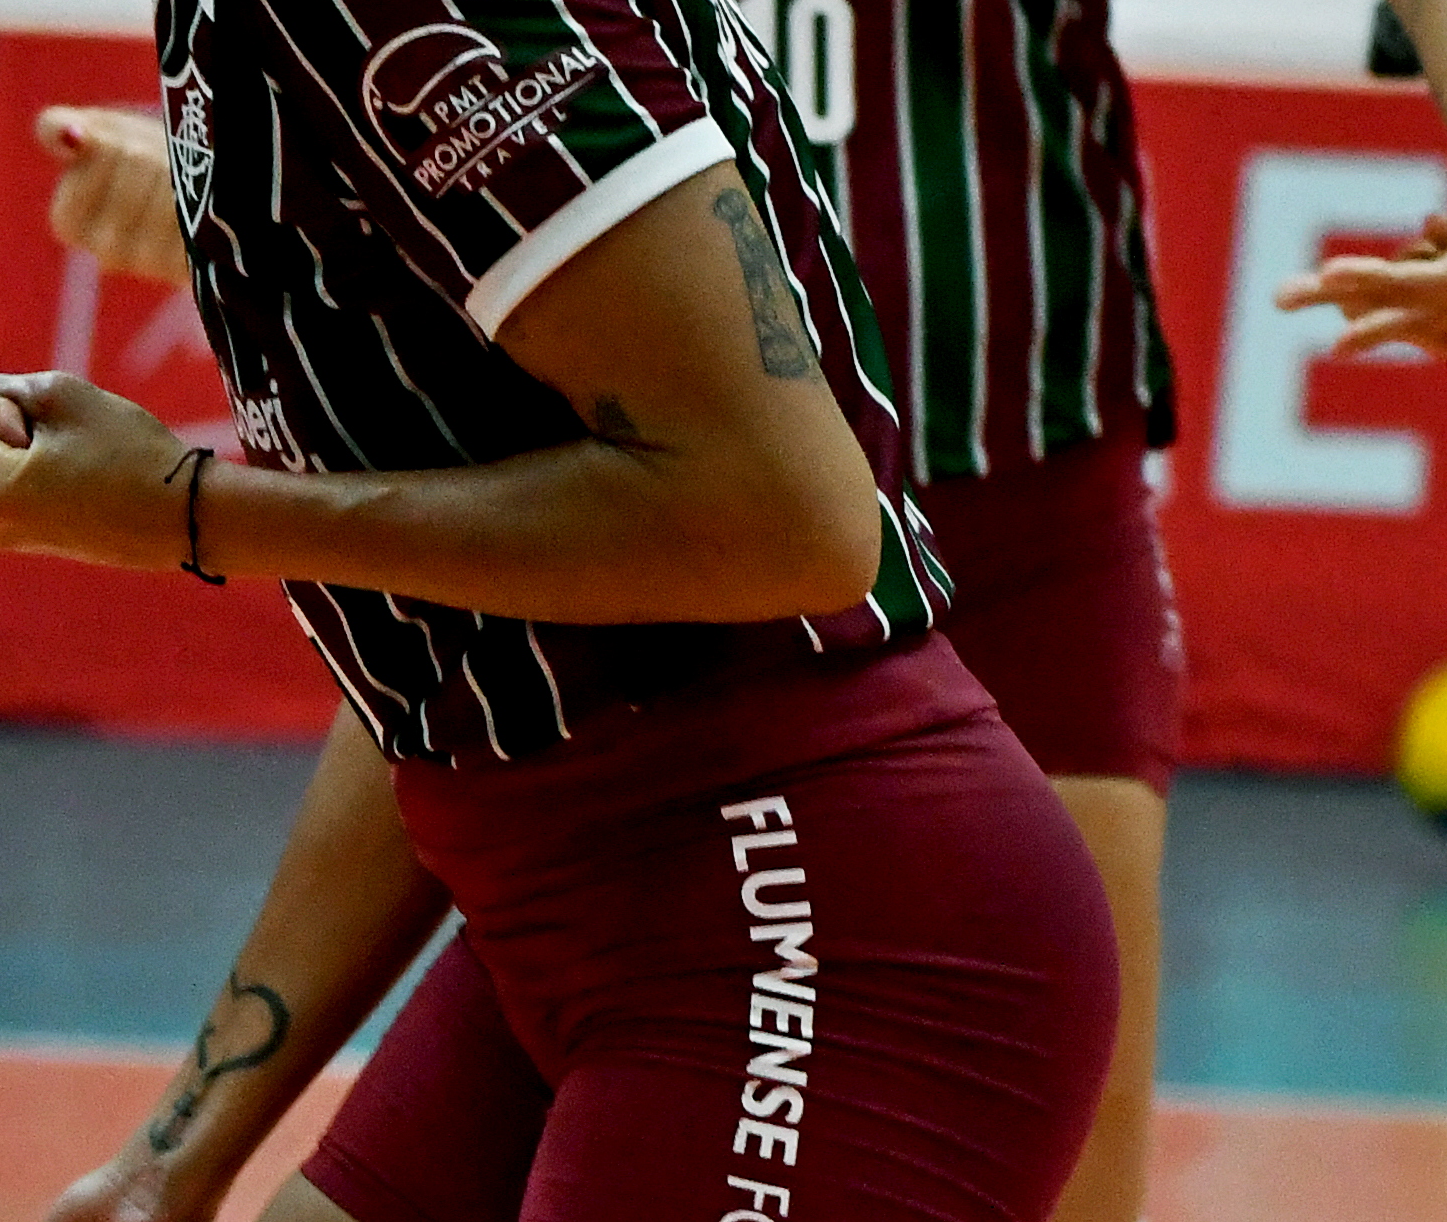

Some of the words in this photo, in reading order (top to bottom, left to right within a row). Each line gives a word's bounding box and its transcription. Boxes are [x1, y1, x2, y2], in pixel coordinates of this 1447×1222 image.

[413, 46, 599, 192] PROMOTIONAL
[433, 74, 489, 124] PMT
[459, 101, 568, 192] TRAVEL
[720, 794, 819, 1167] FLUMNENSE
[718, 1174, 791, 1222] F
